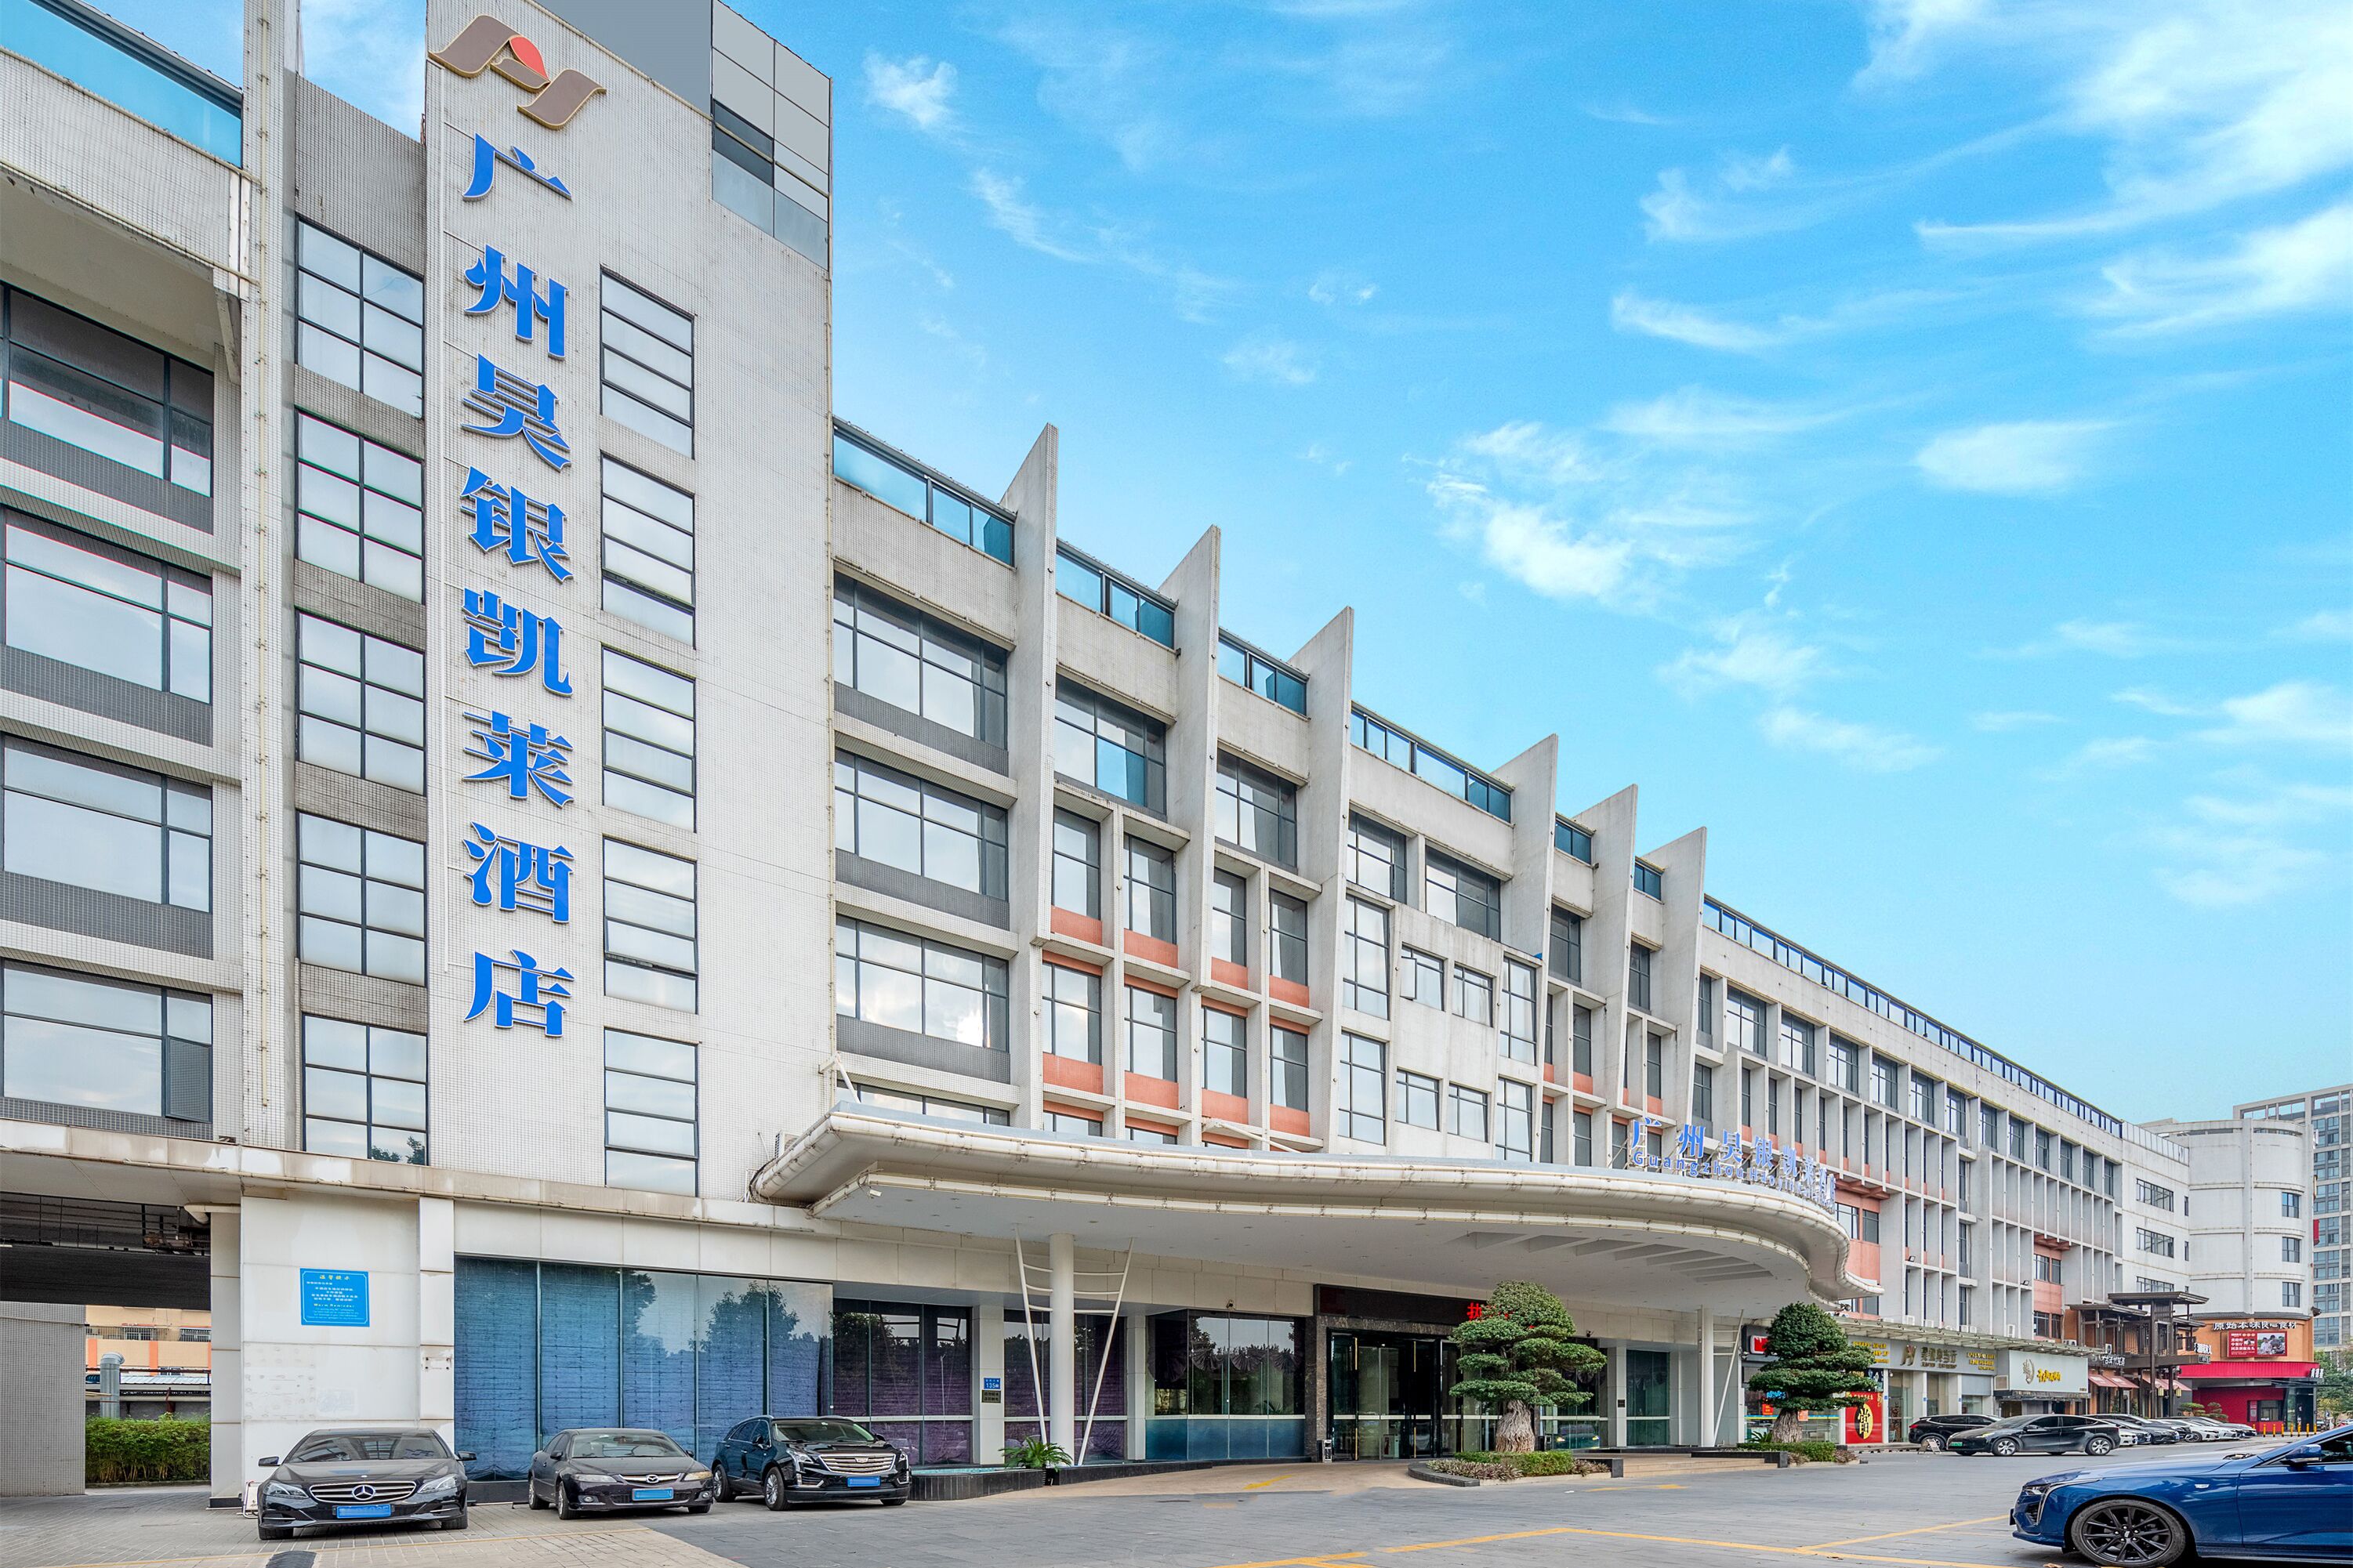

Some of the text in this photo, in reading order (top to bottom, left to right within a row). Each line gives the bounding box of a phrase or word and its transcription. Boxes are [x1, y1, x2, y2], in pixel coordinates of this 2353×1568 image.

[461, 132, 574, 1037] 广州昊银凯莱酒店
[1631, 1117, 1836, 1204] 广州昊银凯莱酒
[1633, 1151, 1744, 1177] Guangzhou
[2213, 1322, 2297, 1331] 原始本味良心食材
